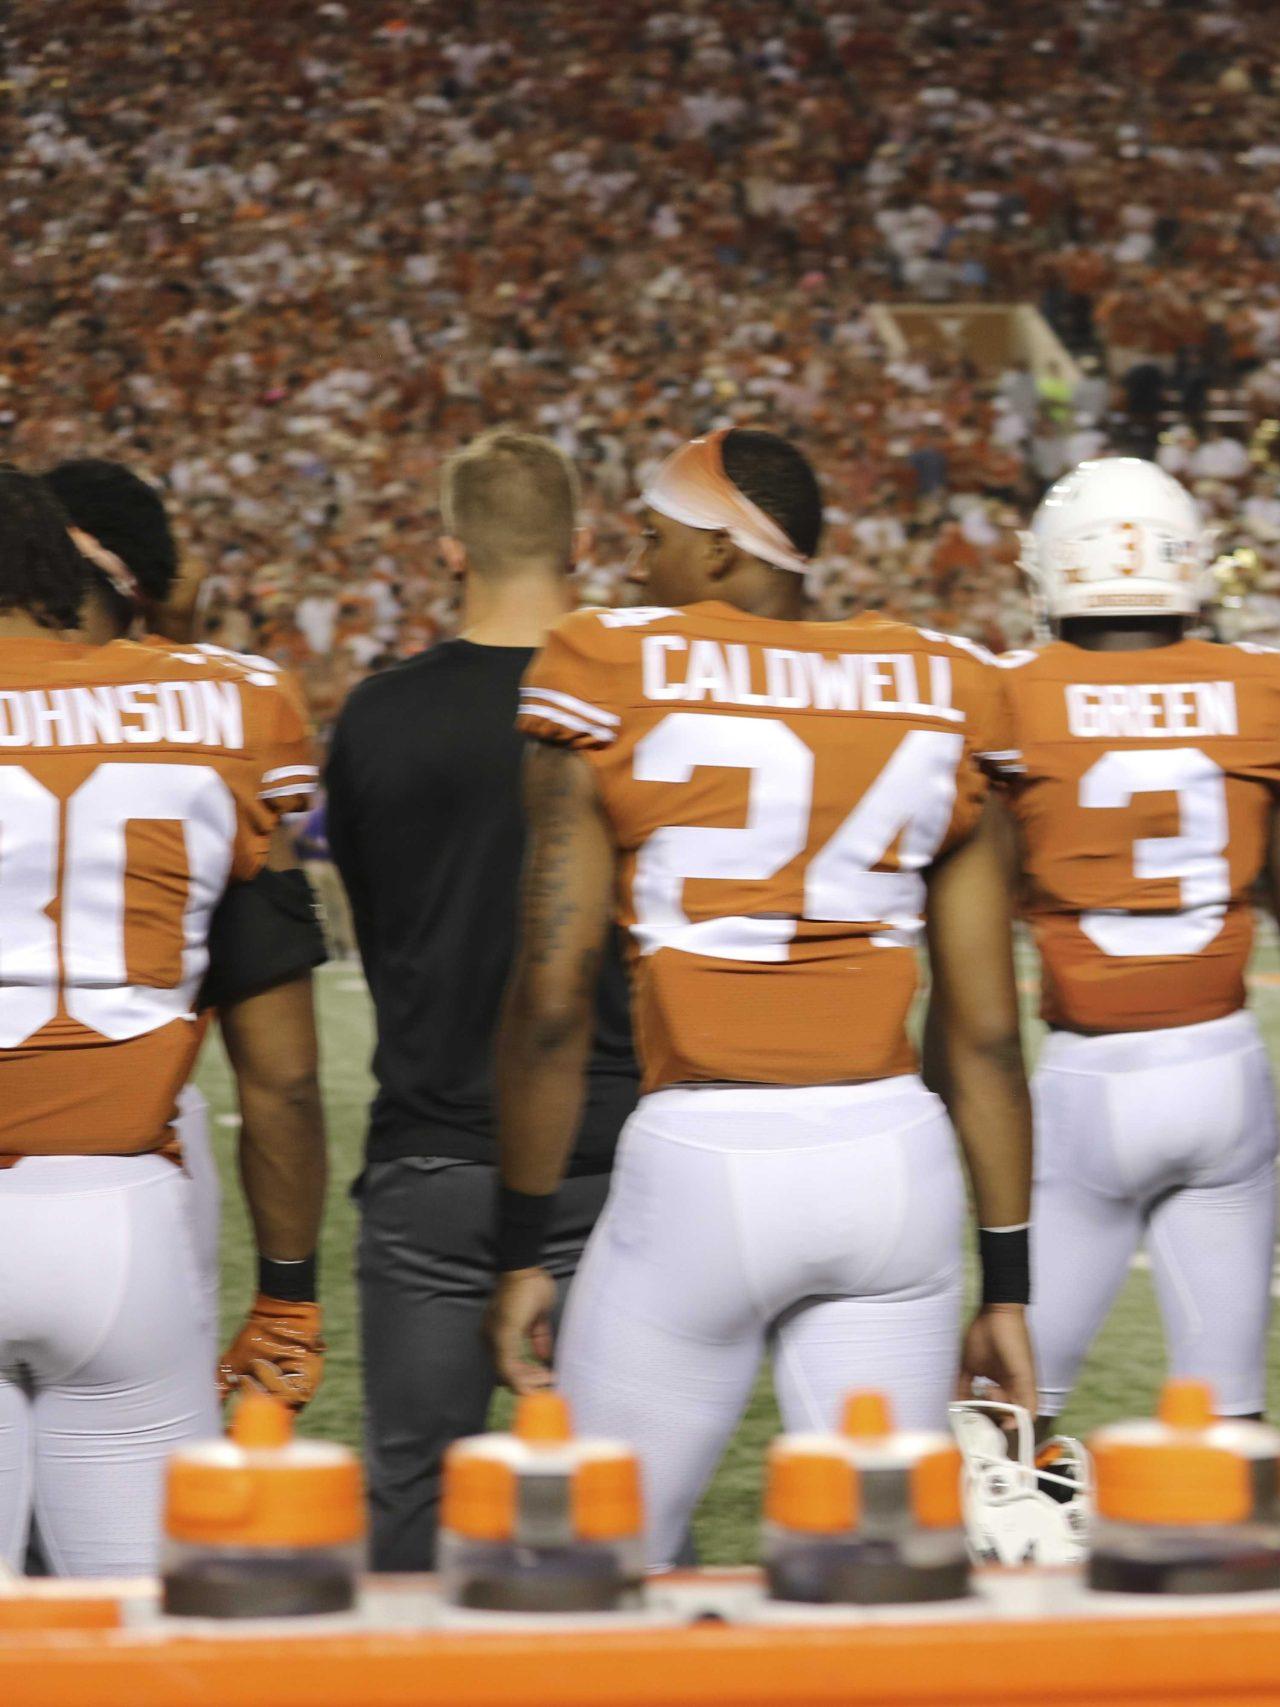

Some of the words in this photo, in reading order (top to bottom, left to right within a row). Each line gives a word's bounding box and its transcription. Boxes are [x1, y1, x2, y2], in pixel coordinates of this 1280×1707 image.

[0, 681, 244, 749] OHNSON
[641, 634, 966, 722] CALDWELL
[1066, 681, 1238, 737] GREEN
[629, 712, 966, 962] 24
[1079, 748, 1230, 957] 3
